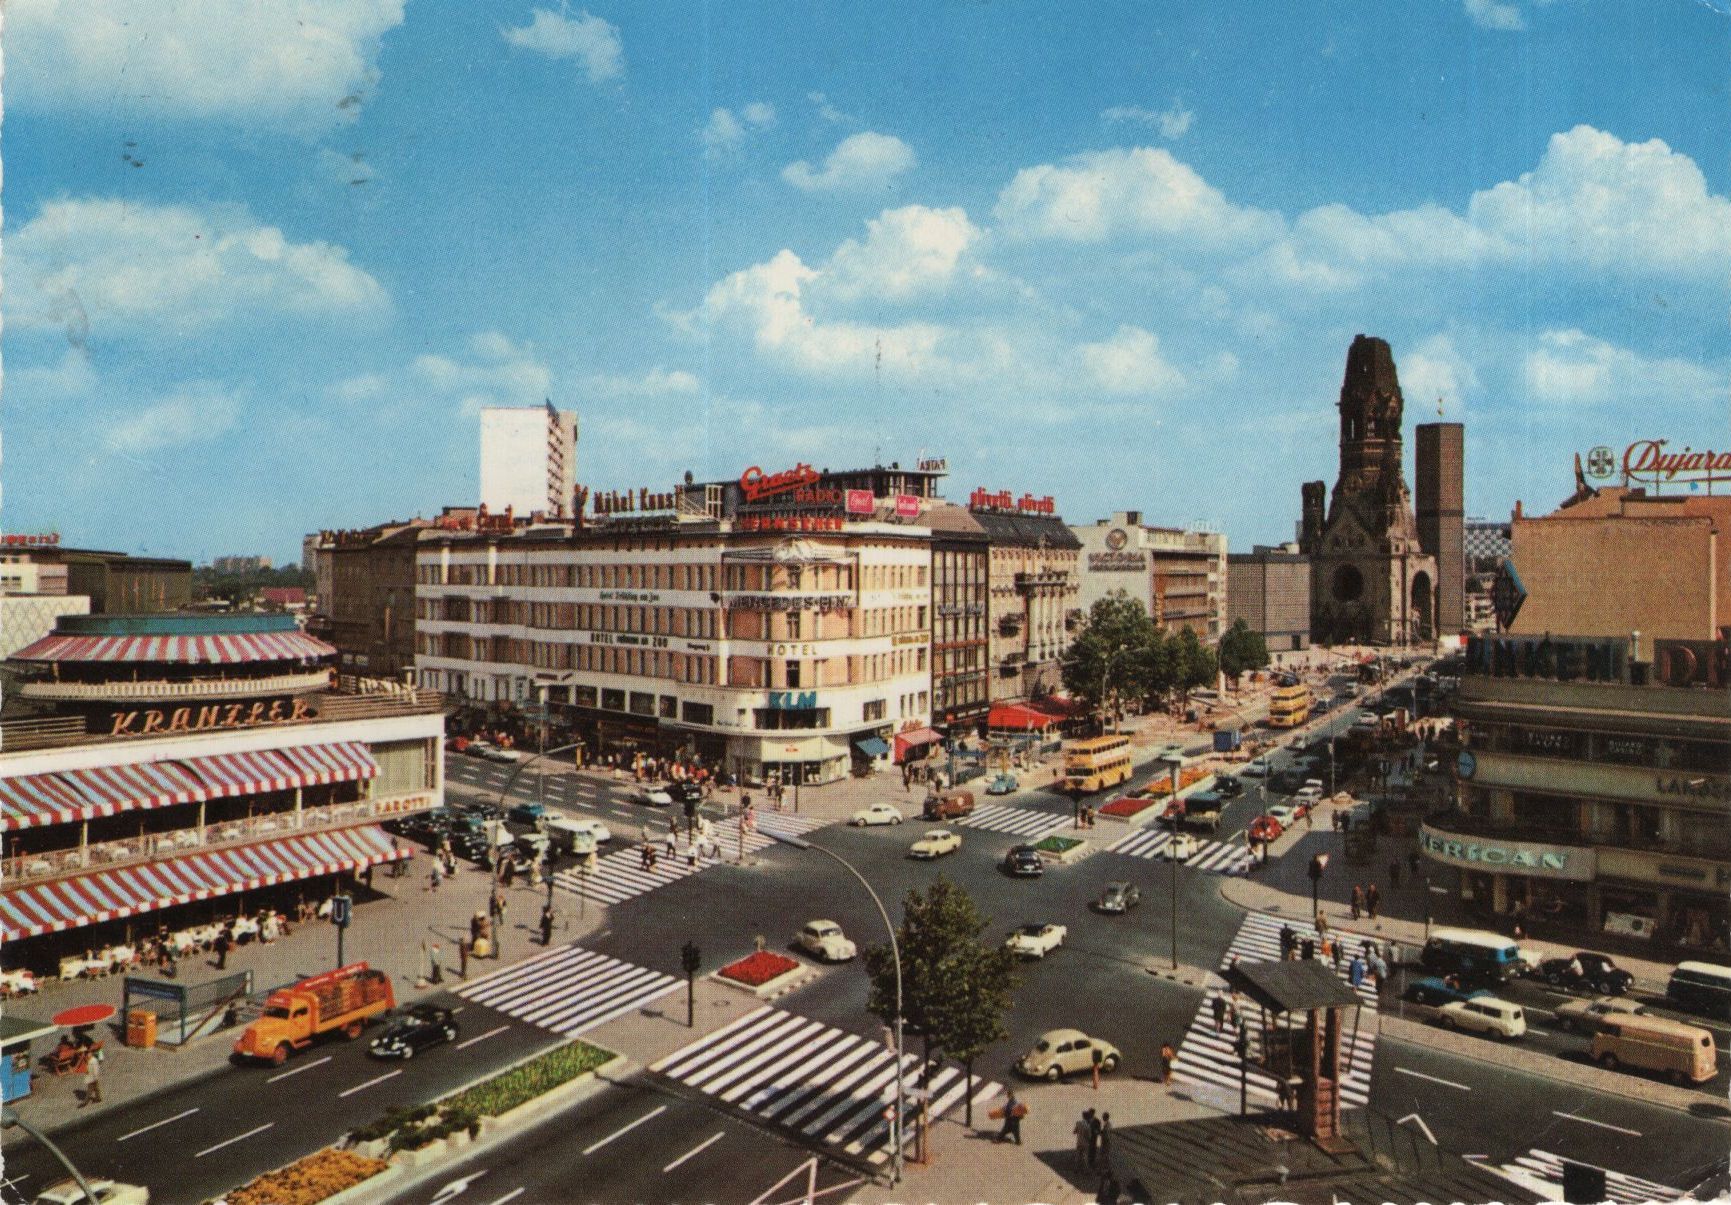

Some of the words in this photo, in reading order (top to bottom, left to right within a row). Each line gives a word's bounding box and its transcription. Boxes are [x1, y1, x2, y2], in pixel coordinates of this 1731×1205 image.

[739, 462, 821, 502] Graetz
[766, 643, 818, 656] HOTEL
[768, 690, 817, 710] KLM
[111, 698, 314, 736] KRANZLER
[333, 900, 345, 921] U
